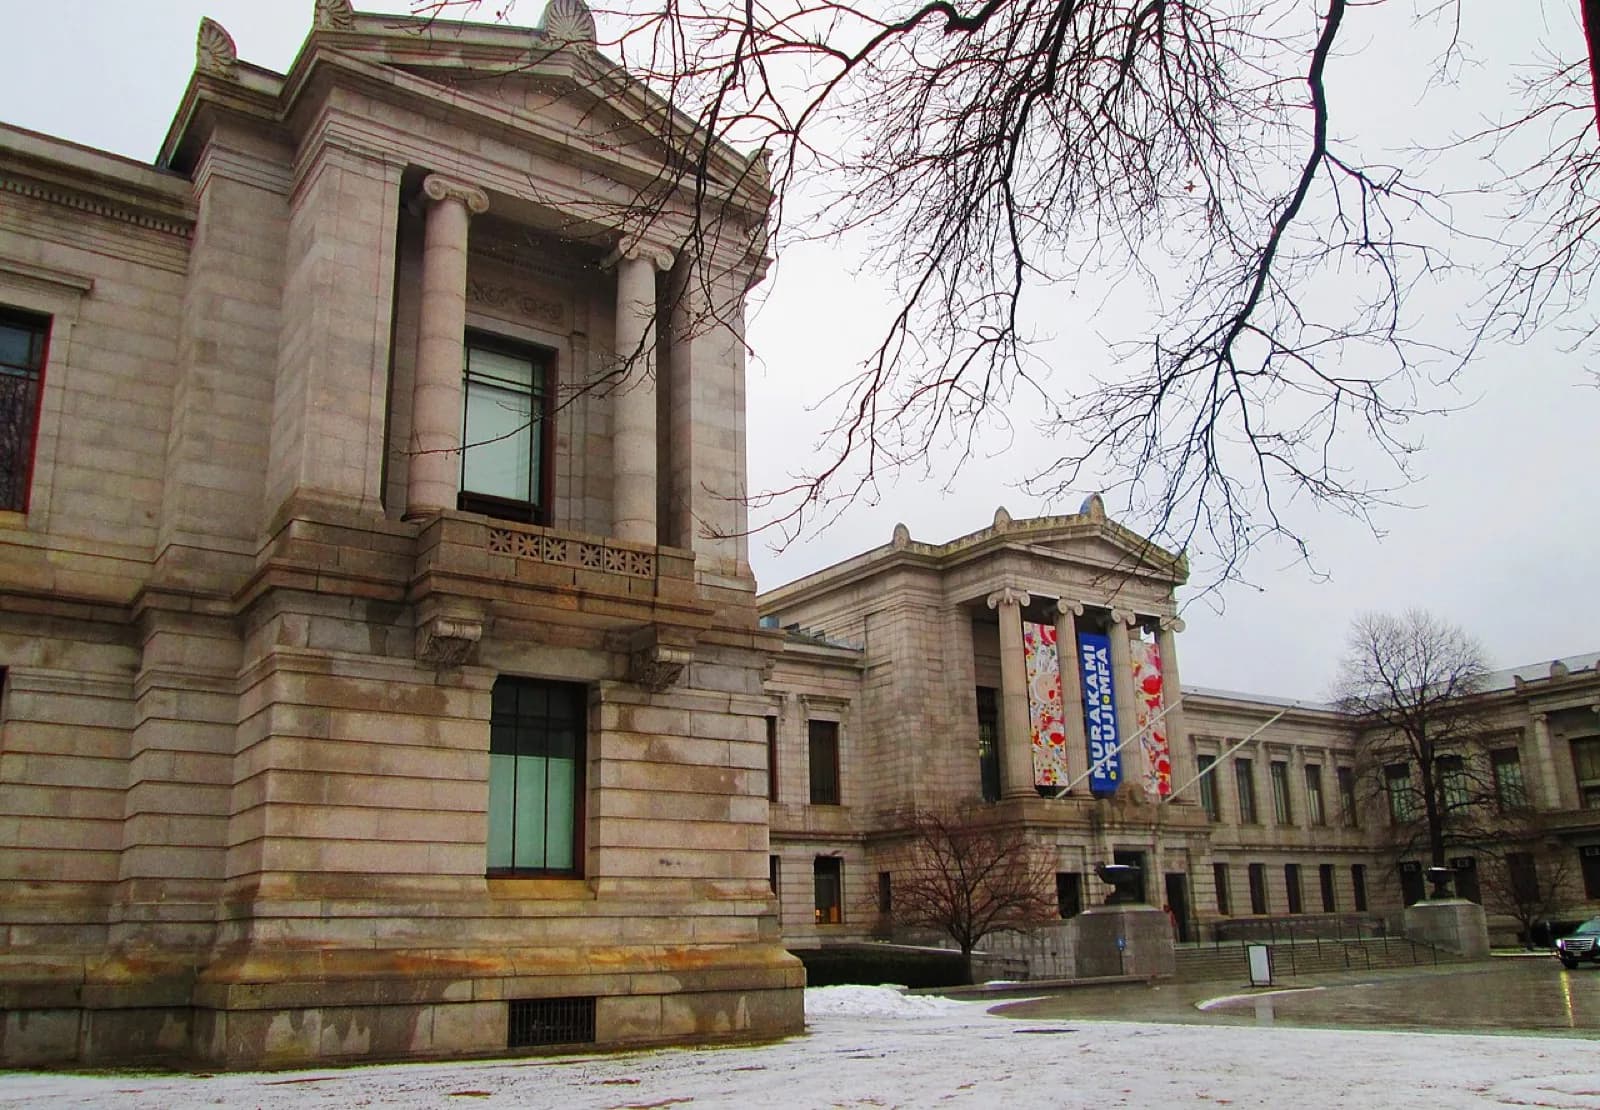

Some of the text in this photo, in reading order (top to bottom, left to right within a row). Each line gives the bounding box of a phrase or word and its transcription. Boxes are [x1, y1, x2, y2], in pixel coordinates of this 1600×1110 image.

[1083, 645, 1106, 779] MURAKAMI
[1096, 647, 1118, 771] TSUJI MFA
